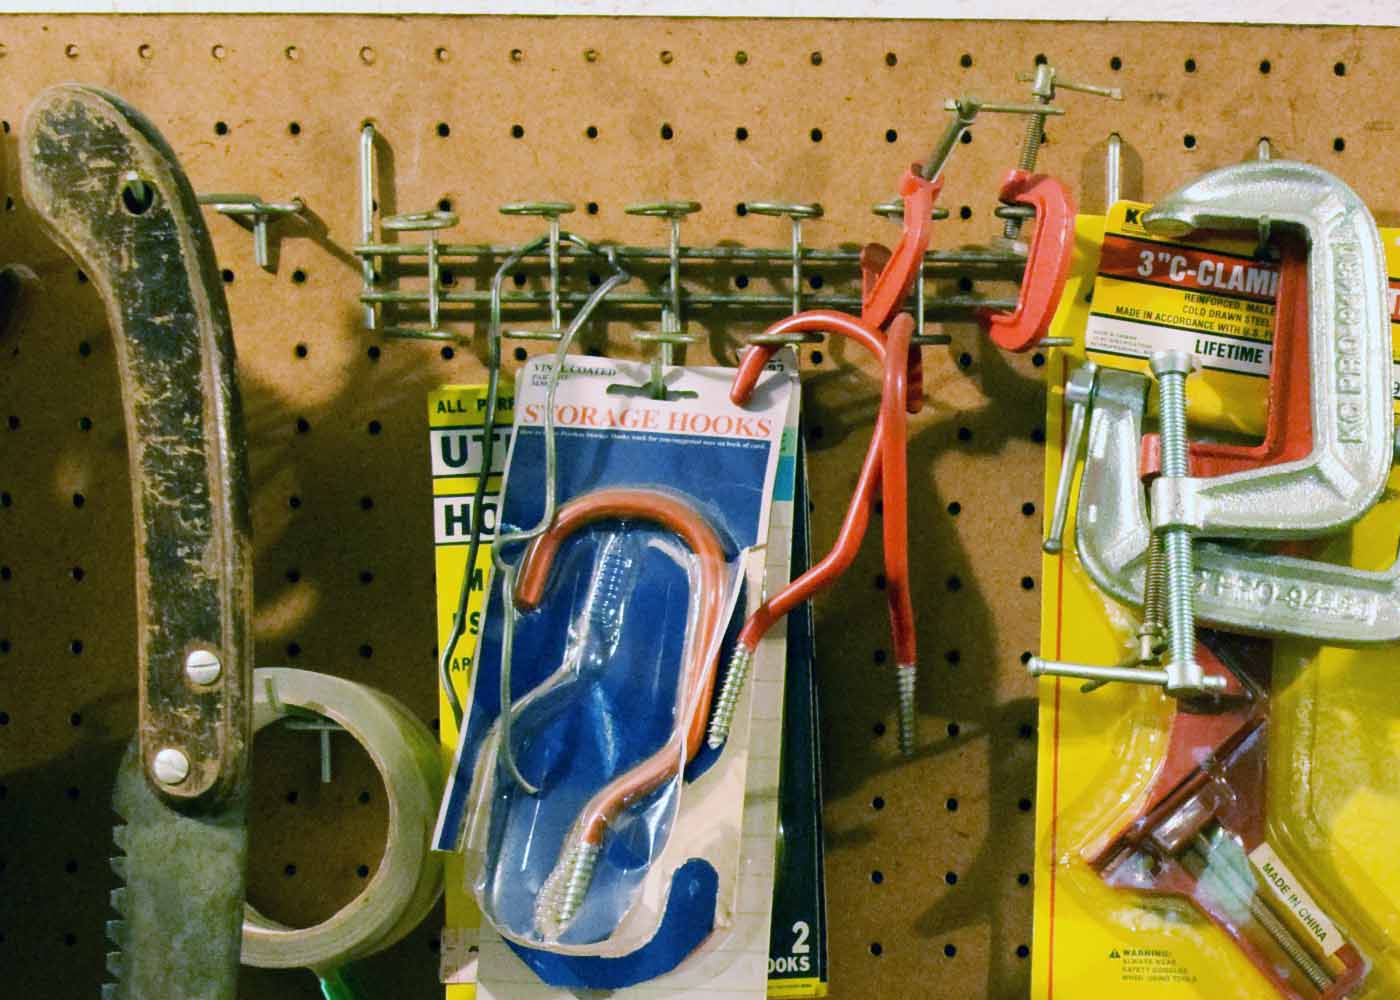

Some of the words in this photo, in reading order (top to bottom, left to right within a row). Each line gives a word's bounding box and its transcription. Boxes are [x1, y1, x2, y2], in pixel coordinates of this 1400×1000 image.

[1115, 306, 1142, 318] MADE
[1143, 311, 1153, 321] IN
[1154, 312, 1216, 331] ACCORDANCE
[1217, 323, 1241, 335] WITH
[1182, 305, 1207, 317] COLD
[1209, 309, 1243, 322] DRAWN
[1194, 339, 1264, 365] LIFETIME
[436, 399, 466, 414] ALL
[667, 411, 772, 439] HOOKS
[1262, 863, 1291, 895] MADE
[1298, 907, 1328, 942] CHINA
[791, 920, 810, 954] 2
